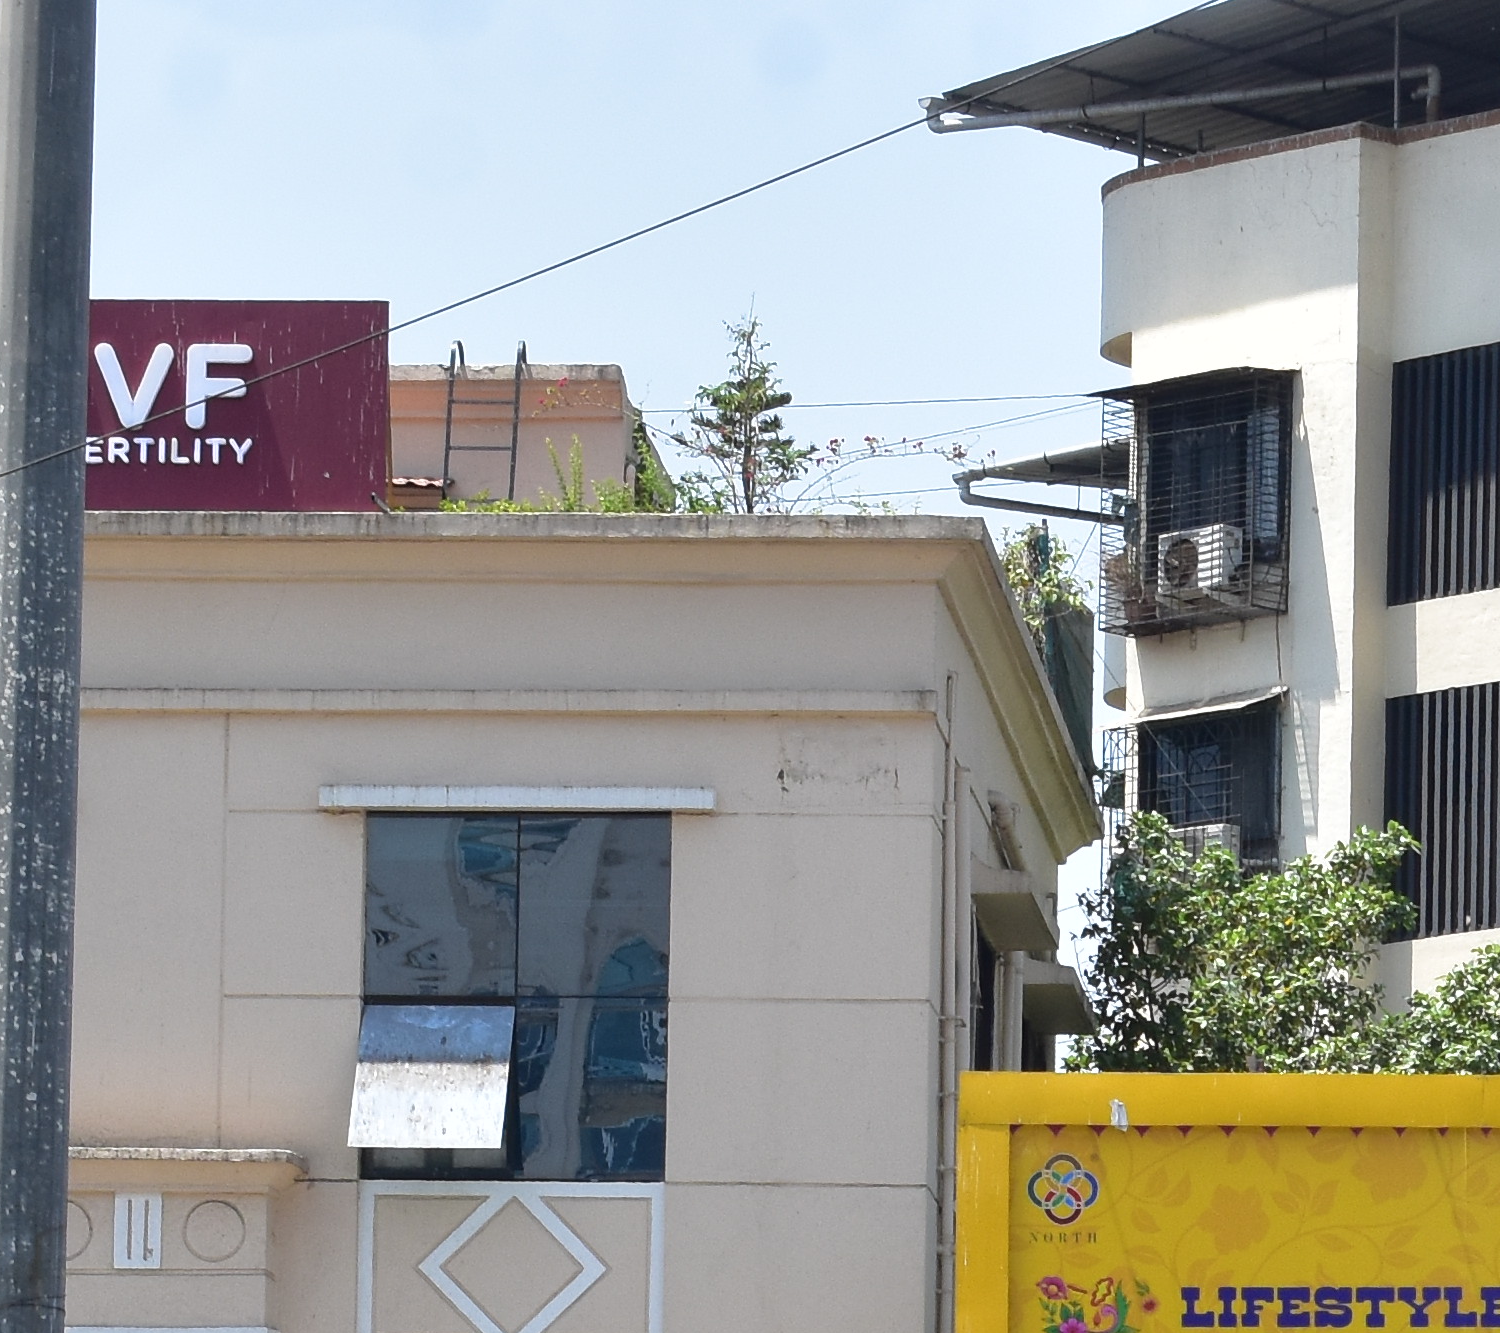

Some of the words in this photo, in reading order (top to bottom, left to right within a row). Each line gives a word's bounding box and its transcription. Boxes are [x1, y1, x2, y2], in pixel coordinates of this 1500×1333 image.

[93, 342, 253, 431] VF
[85, 437, 253, 466] ERTILITY
[1028, 1231, 1098, 1244] NORTH
